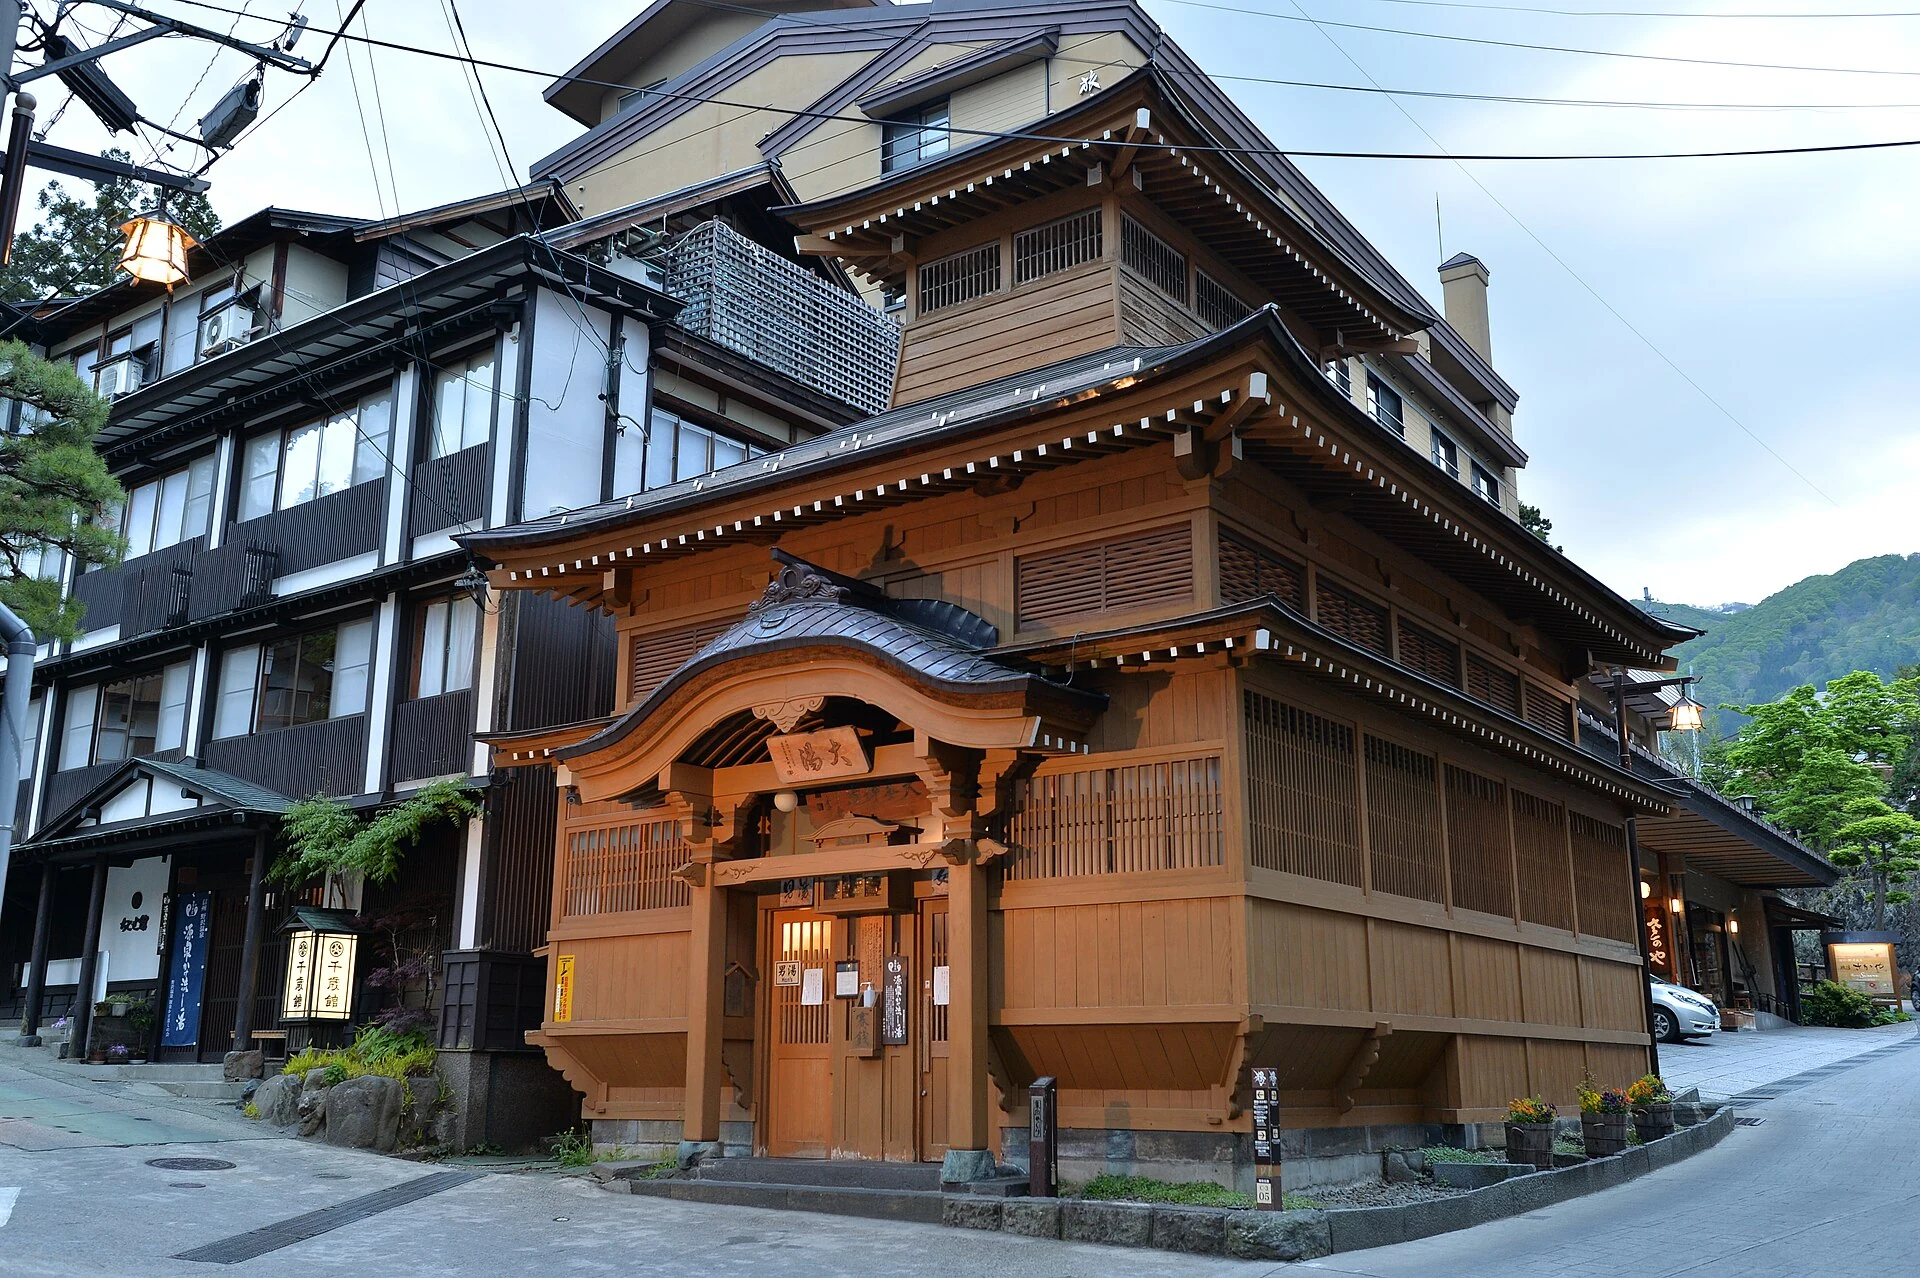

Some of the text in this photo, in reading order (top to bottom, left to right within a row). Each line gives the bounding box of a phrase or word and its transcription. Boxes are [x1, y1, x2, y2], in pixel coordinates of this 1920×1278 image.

[293, 961, 306, 1008] 千歳館
[325, 961, 343, 1008] 千歳館
[778, 964, 797, 977] 男湯
[1258, 1192, 1270, 1201] 05
